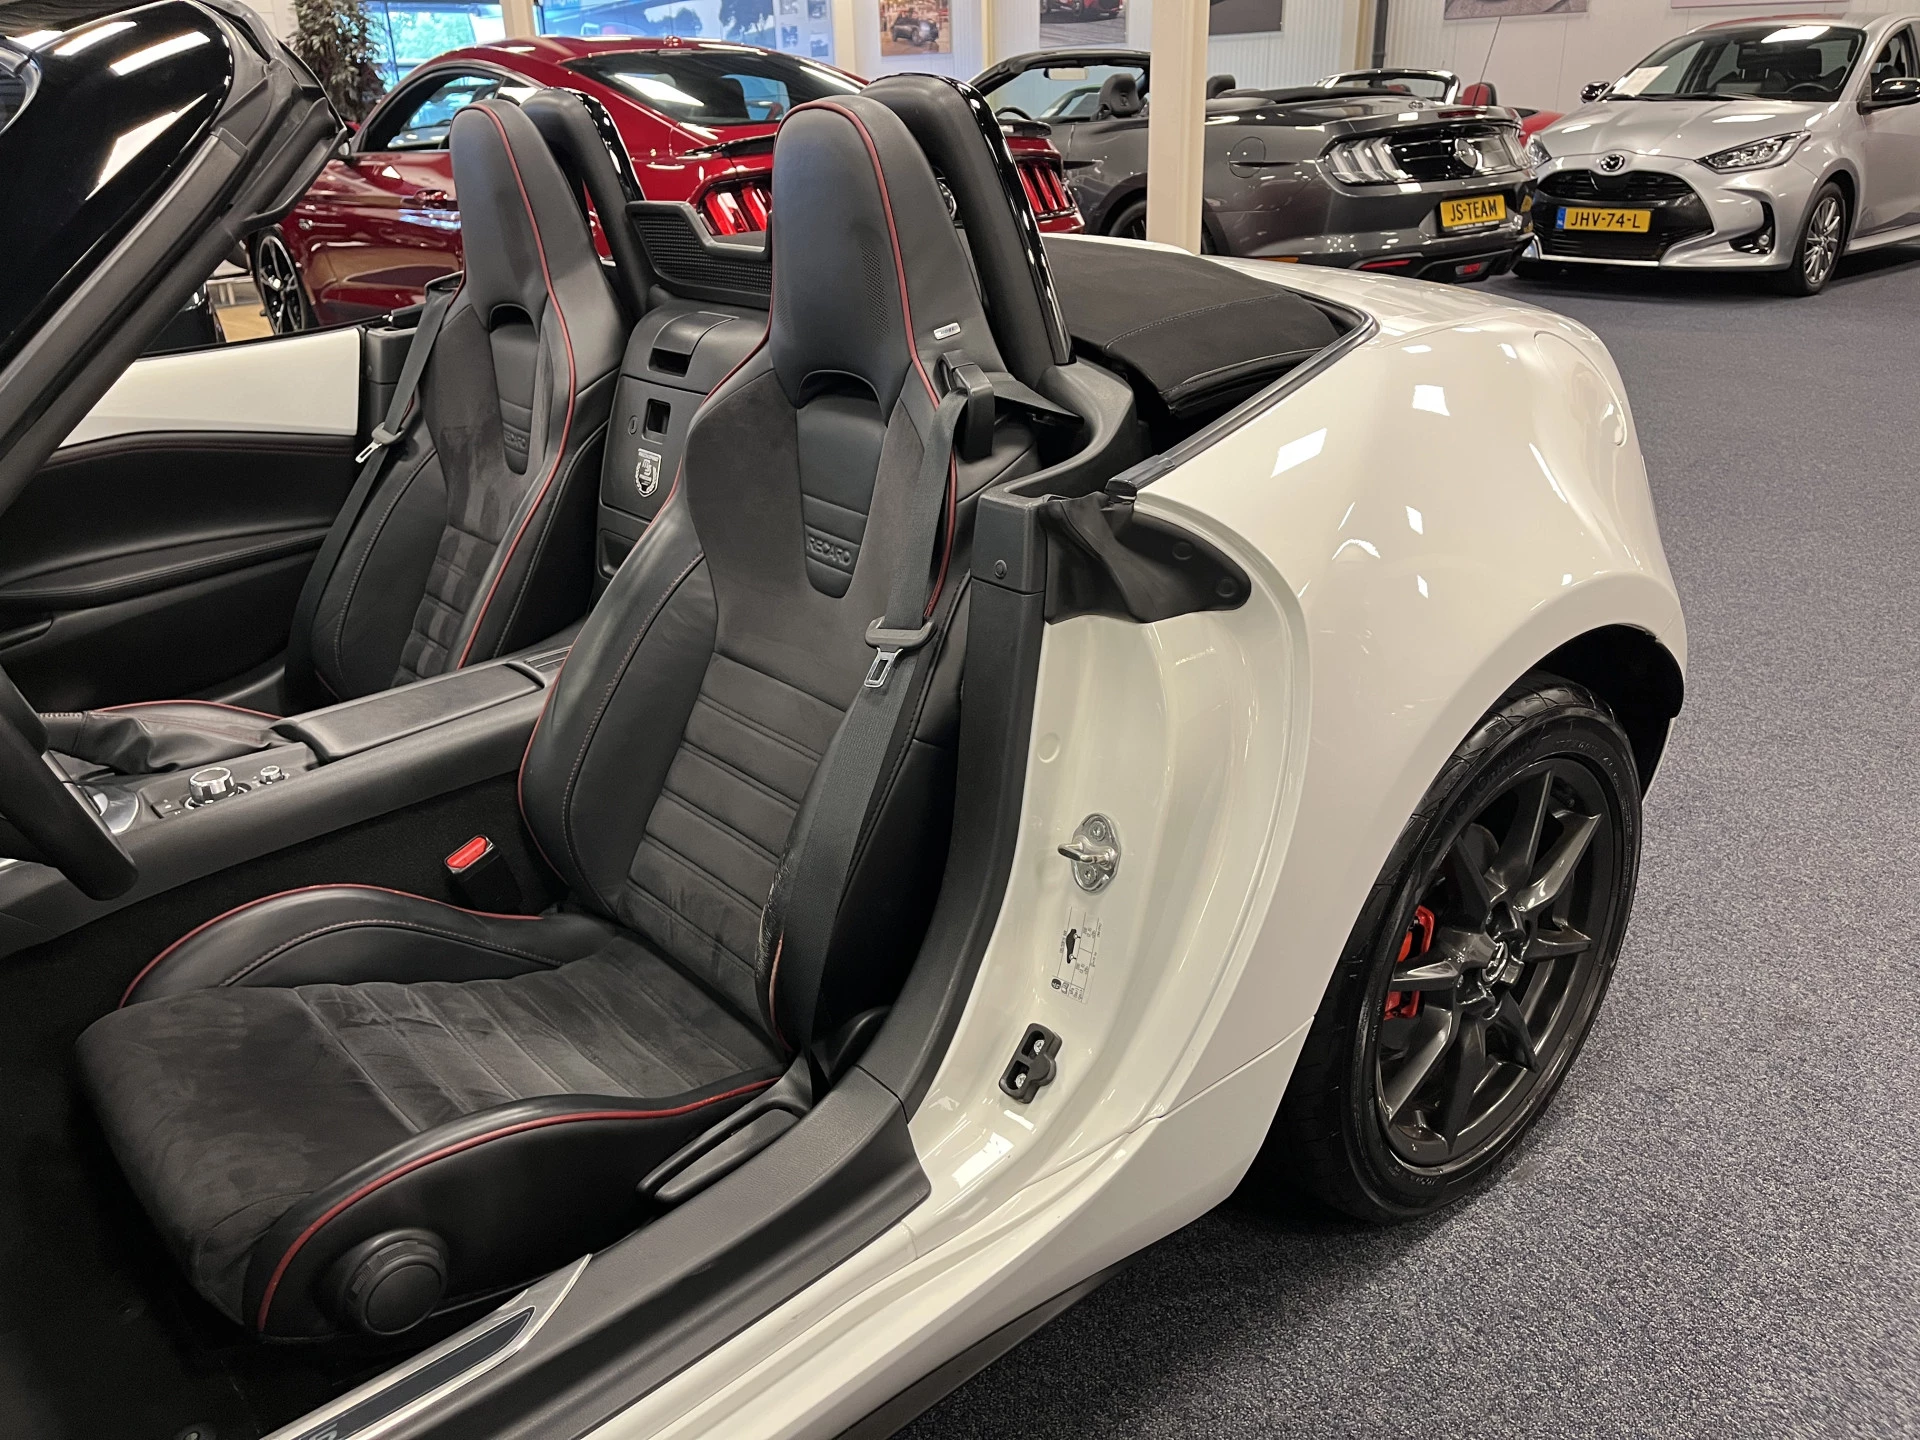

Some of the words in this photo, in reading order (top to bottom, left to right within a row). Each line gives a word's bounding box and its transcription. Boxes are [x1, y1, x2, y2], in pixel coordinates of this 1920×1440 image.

[1450, 199, 1498, 222] JS-TEAM
[1571, 211, 1641, 228] JHV-74-L
[807, 535, 851, 566] RECARO
